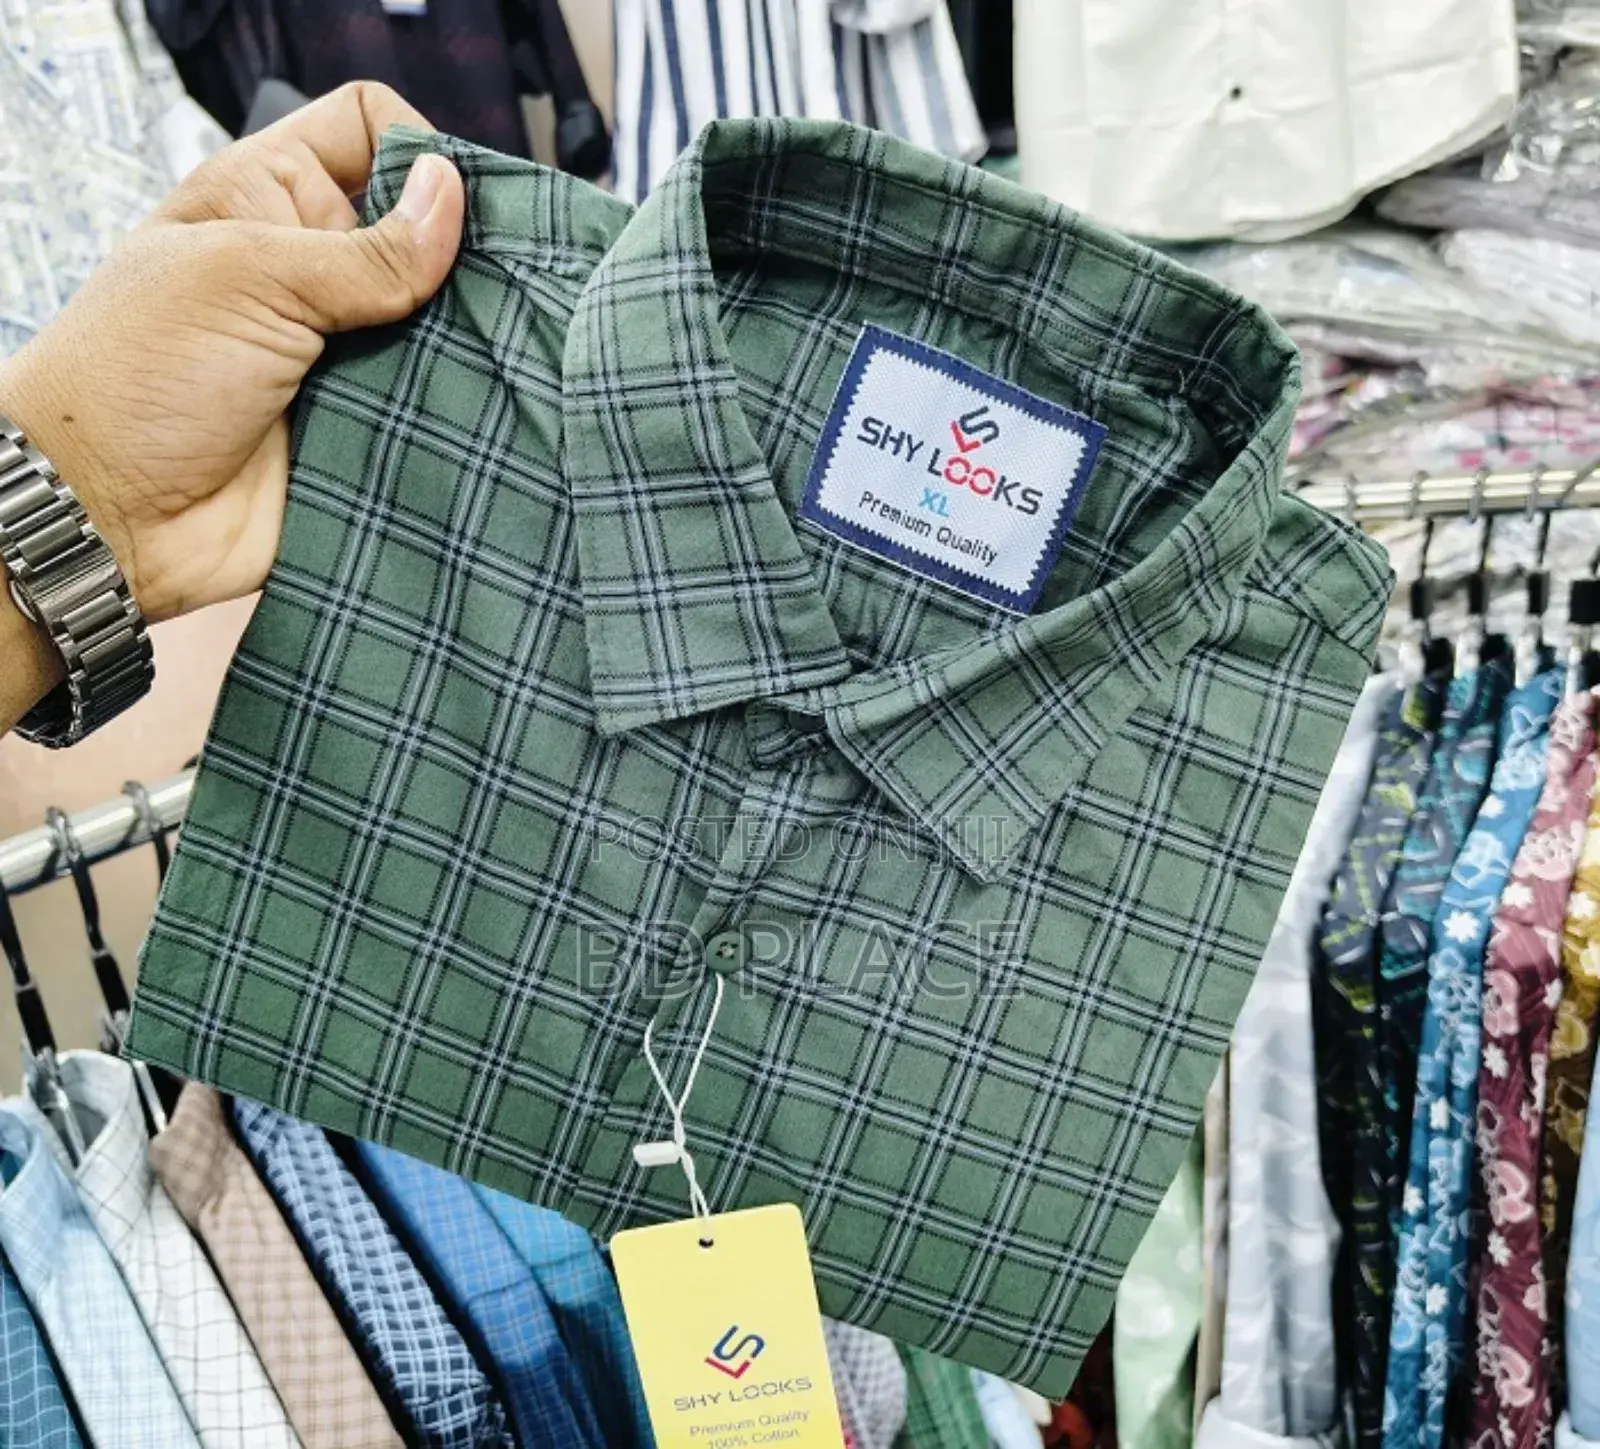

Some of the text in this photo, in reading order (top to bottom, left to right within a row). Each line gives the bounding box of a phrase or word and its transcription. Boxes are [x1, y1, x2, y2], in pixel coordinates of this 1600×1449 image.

[857, 416, 1043, 515] SHY LOOKS
[918, 488, 949, 518] XL
[859, 491, 998, 567] Premium Quality
[674, 1377, 812, 1411] SHY LOOKS
[690, 1419, 755, 1437] Premium
